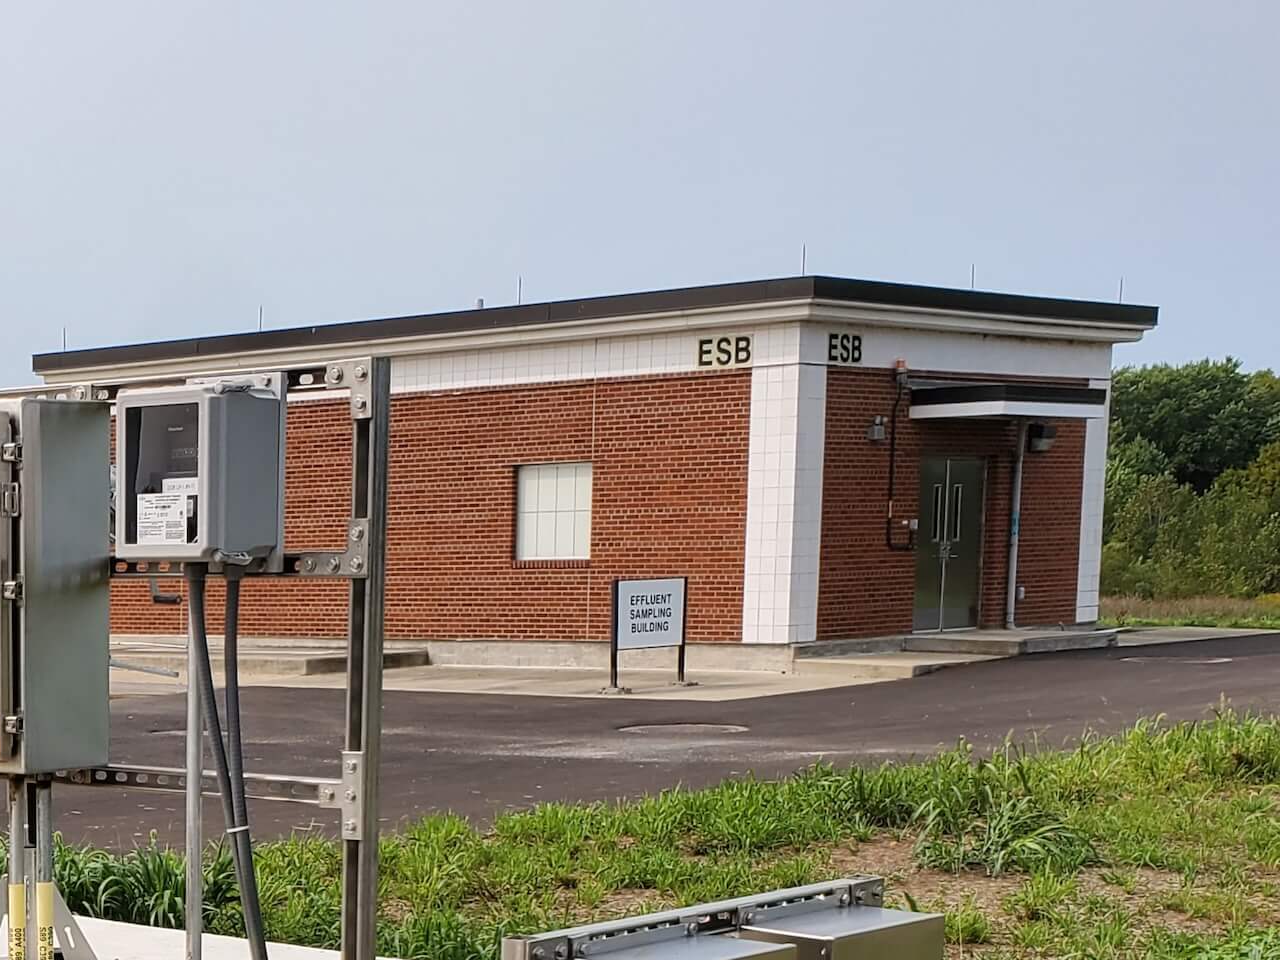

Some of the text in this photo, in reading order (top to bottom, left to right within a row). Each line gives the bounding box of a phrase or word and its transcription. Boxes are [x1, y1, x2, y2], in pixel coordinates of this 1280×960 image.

[698, 336, 751, 366] ESB
[828, 333, 862, 363] ESB
[630, 594, 672, 606] EFFLUENT
[630, 607, 672, 620] SAMPLING
[631, 621, 669, 633] BUILDING
